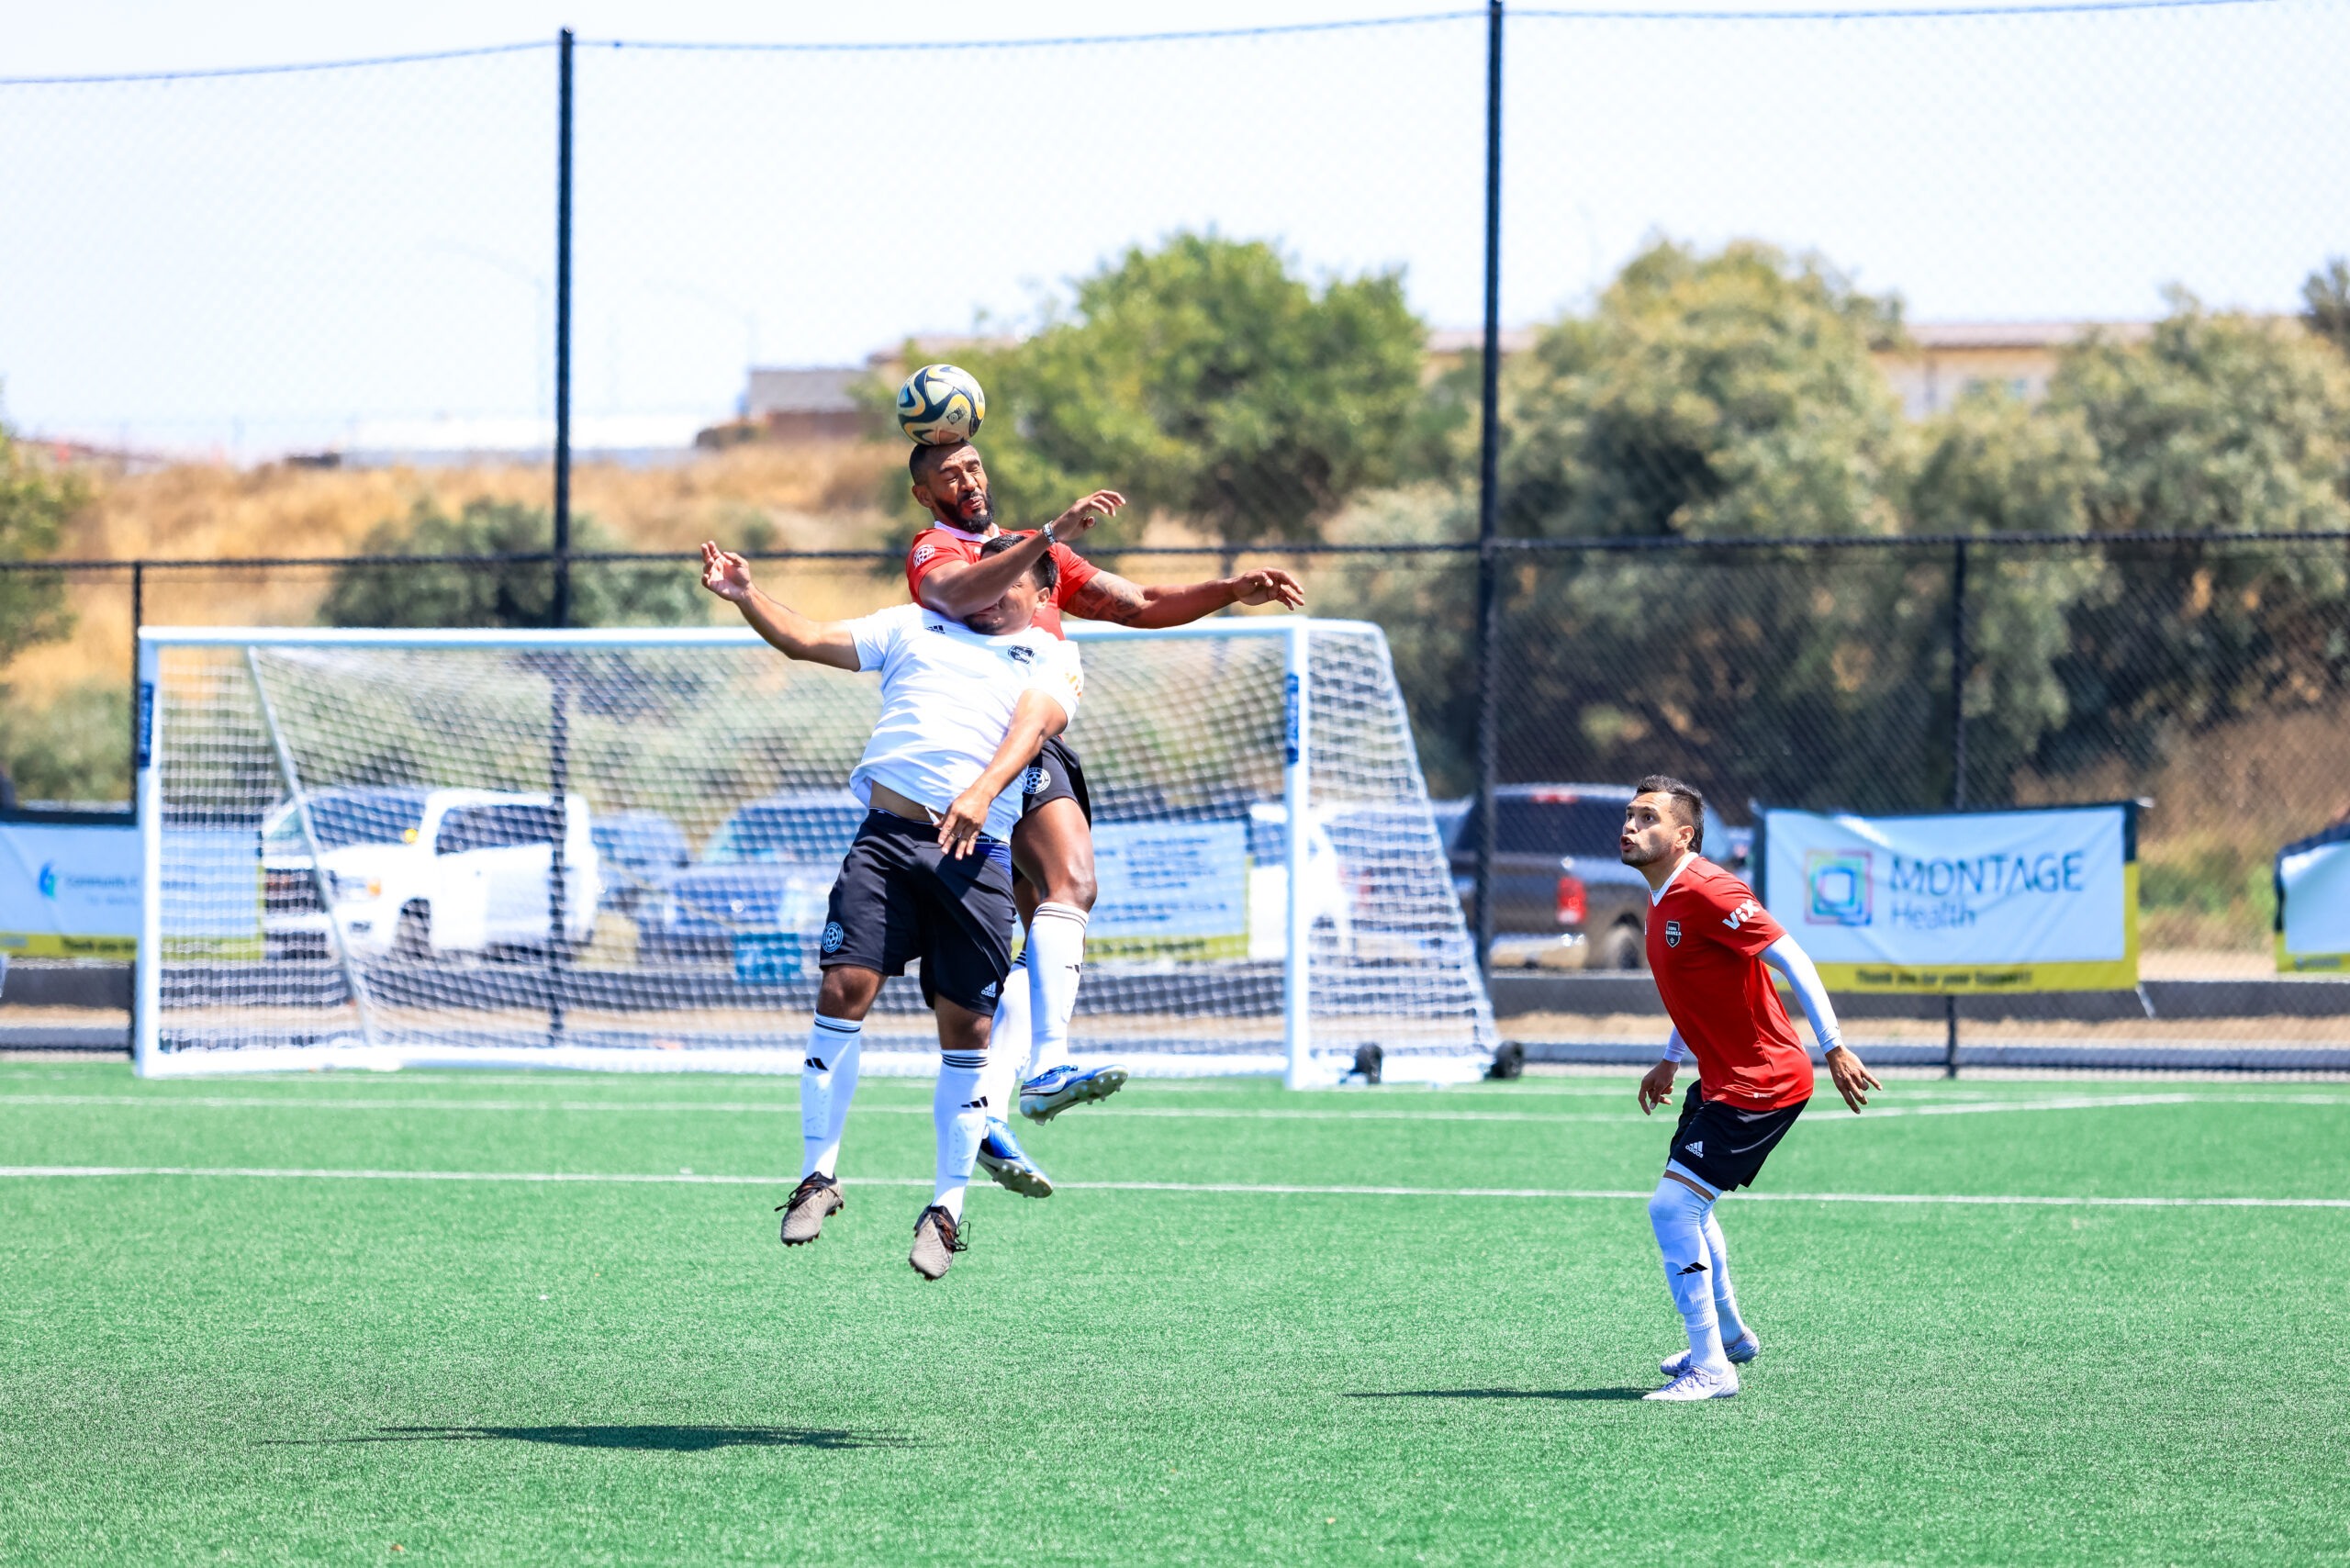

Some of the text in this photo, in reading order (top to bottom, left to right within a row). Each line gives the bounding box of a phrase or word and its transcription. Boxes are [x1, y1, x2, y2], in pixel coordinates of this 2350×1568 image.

[1890, 850, 2084, 897] MONTAGE
[1891, 900, 1976, 930] Health
[1685, 1145, 1704, 1159] adidas
